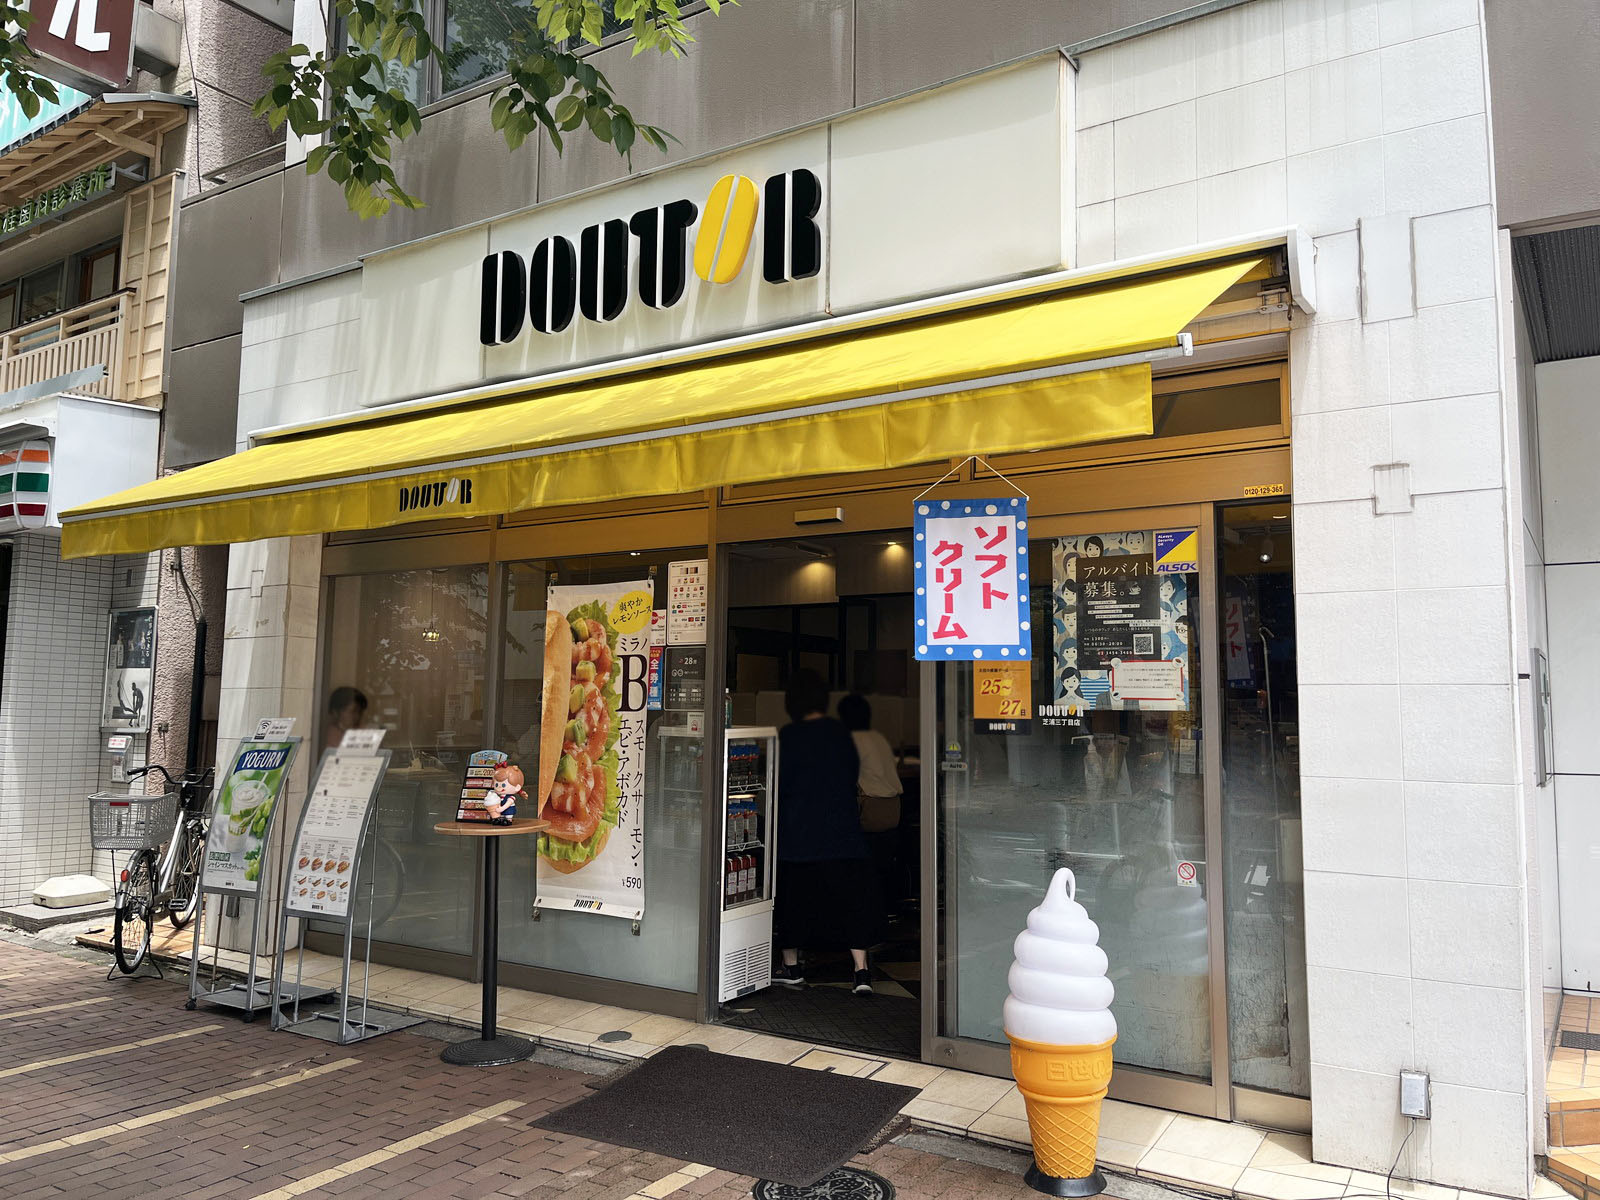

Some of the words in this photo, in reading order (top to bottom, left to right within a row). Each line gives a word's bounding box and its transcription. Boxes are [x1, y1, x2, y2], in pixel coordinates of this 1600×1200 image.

[480, 168, 822, 346] DOUTOR
[399, 477, 473, 512] DOUTOR
[974, 526, 1009, 609] ソフト
[1083, 561, 1152, 579] アルバイト
[1156, 562, 1197, 573] ALSOK
[932, 540, 968, 640] クリーム
[619, 597, 643, 613] 爽やか
[612, 605, 652, 624] レモンソース
[620, 637, 648, 652] ミラノ
[615, 654, 648, 713] B
[1039, 703, 1084, 718] DOUTOR
[1042, 718, 1081, 726] 芝浦三丁目店
[242, 751, 286, 769] YOGURN
[622, 877, 642, 889] ¥590
